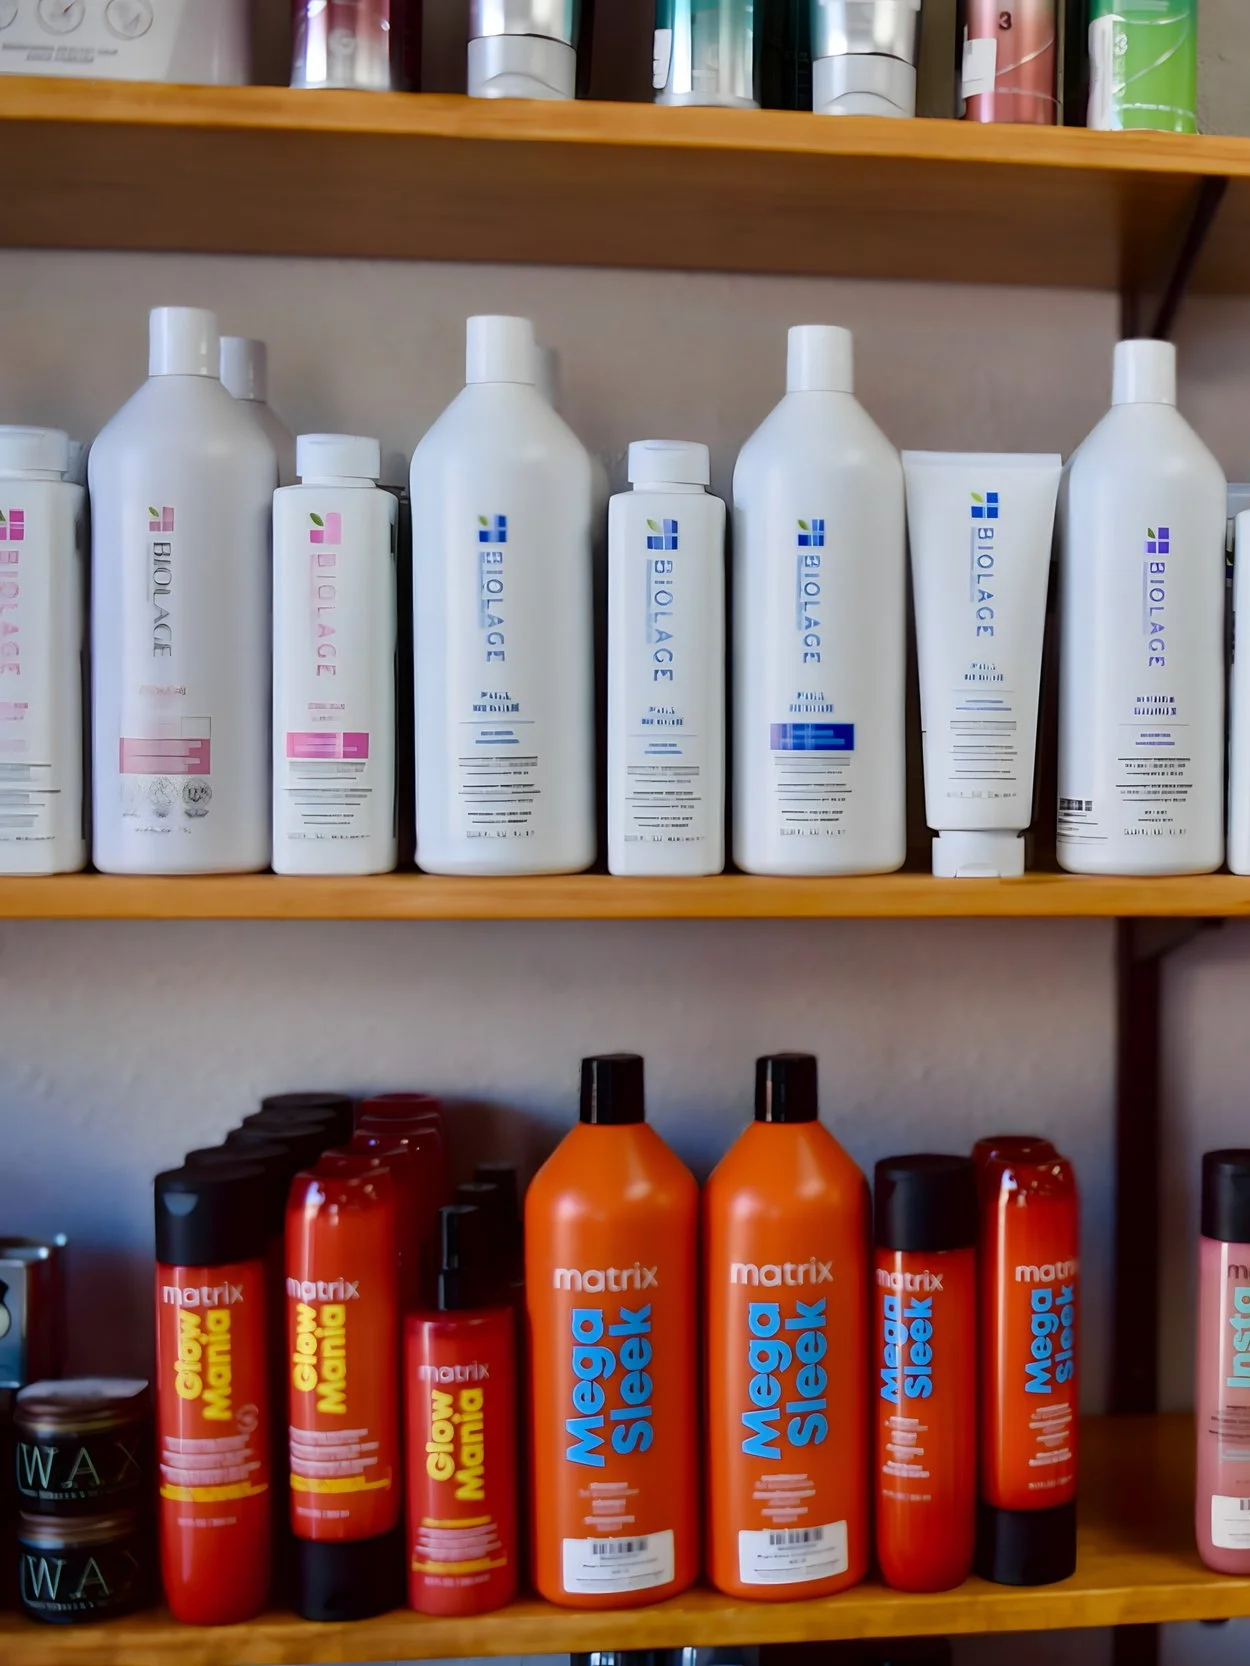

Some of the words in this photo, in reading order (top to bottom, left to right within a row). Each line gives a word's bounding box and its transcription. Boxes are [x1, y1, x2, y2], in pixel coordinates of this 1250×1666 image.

[152, 541, 172, 657] BIOLAGE
[316, 553, 337, 677] BIOLAGE
[485, 551, 506, 663] BIOLAGE
[653, 560, 674, 682] BIOLAGE
[803, 555, 821, 663] BIOLAGE
[975, 527, 995, 637] BIOLAGE
[1148, 562, 1166, 667] BIOLAGE
[163, 1282, 244, 1305] matrix
[287, 1276, 360, 1301] matrix
[553, 1262, 659, 1293] matrix
[730, 1257, 834, 1287] matrix
[876, 1270, 944, 1292] matrix
[174, 1309, 202, 1400] Glow
[202, 1308, 232, 1421] Mania
[293, 1303, 317, 1392] Glow
[316, 1304, 347, 1415] Mania
[419, 1361, 490, 1383] matrix
[565, 1308, 616, 1467] Mega
[608, 1303, 653, 1454] Sleek
[741, 1302, 792, 1460] Mega
[785, 1297, 828, 1447] Sleek
[880, 1296, 908, 1403] Mega
[904, 1296, 933, 1399] Sleek
[1024, 1288, 1059, 1394] Mega
[1055, 1285, 1074, 1383] Sleek
[425, 1389, 455, 1481] Glow
[454, 1388, 485, 1500] Mania
